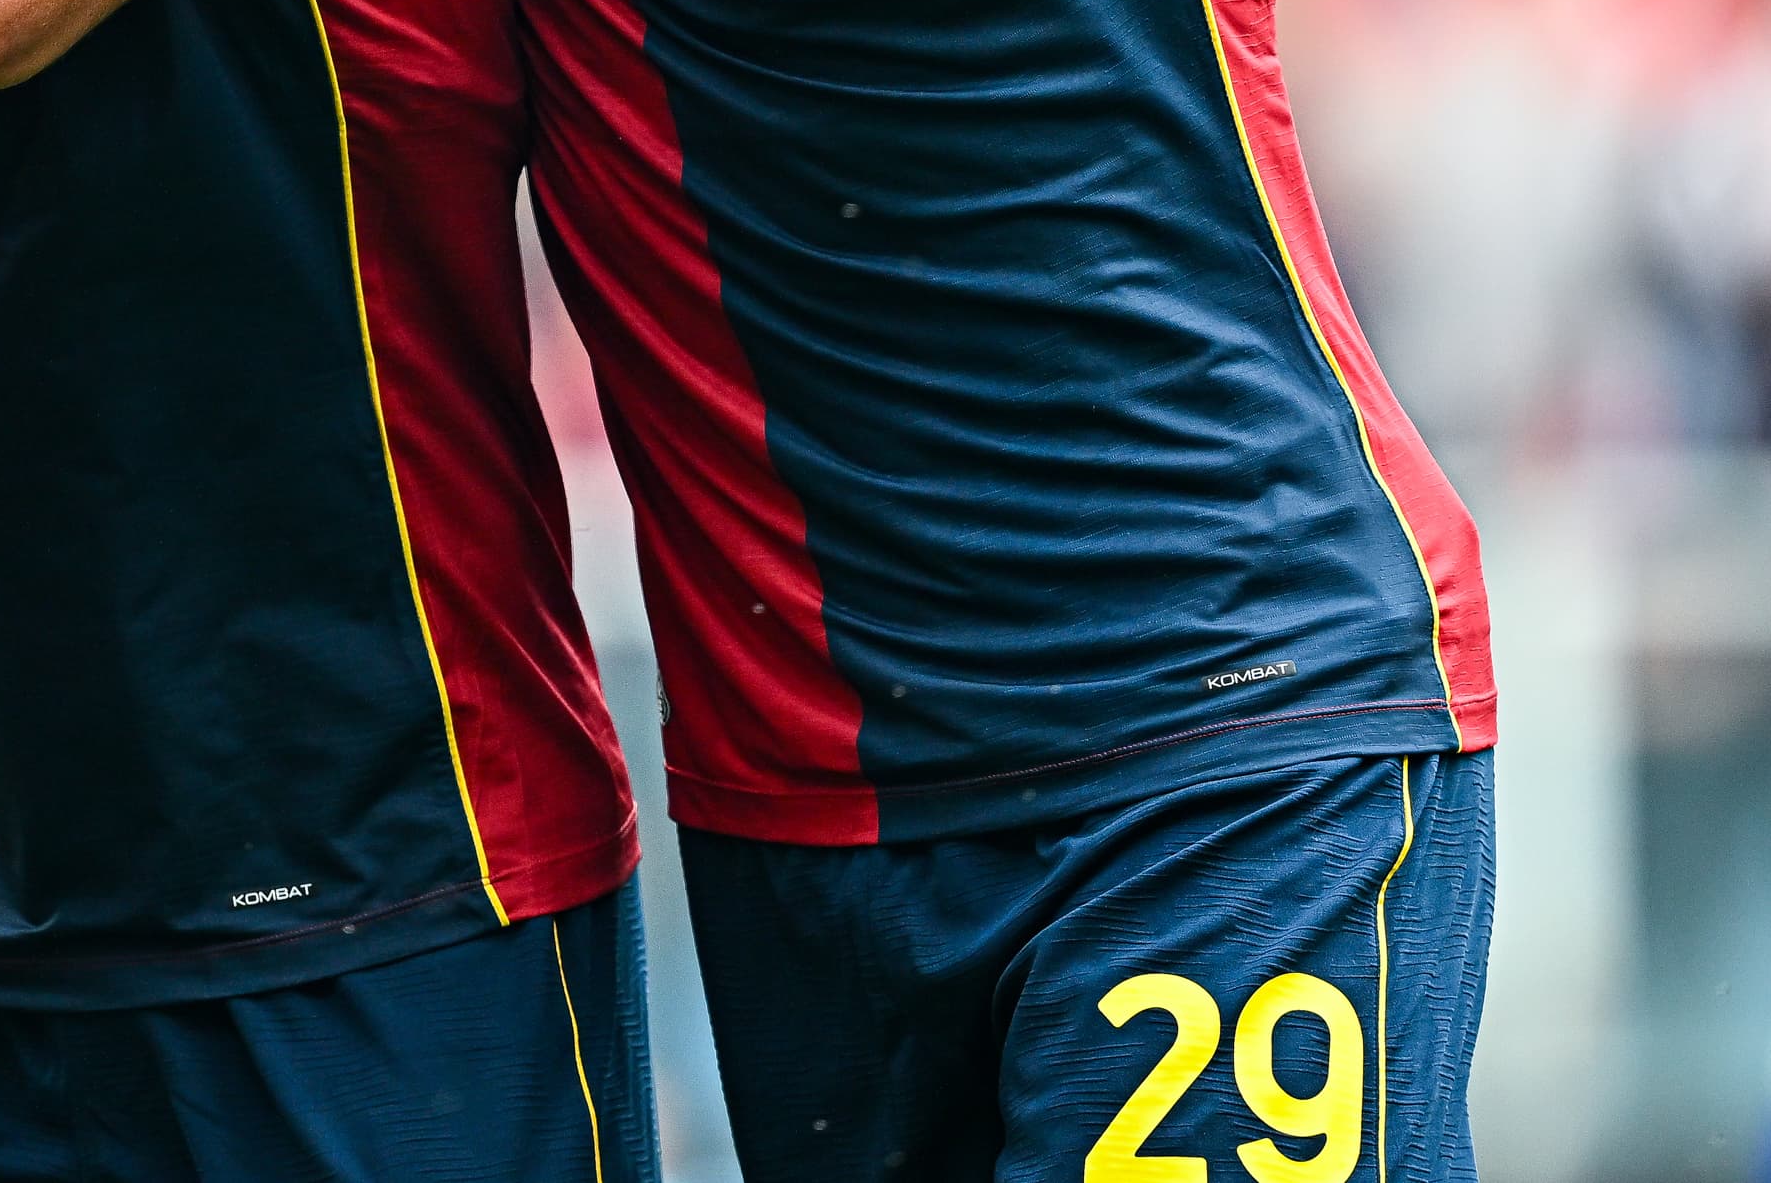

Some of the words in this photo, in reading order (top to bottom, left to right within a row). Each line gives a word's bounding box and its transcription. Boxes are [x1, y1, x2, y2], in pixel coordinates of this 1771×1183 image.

[1207, 663, 1289, 690] KOMBAT
[232, 883, 313, 907] KOMBAT
[1083, 971, 1365, 1183] 29
